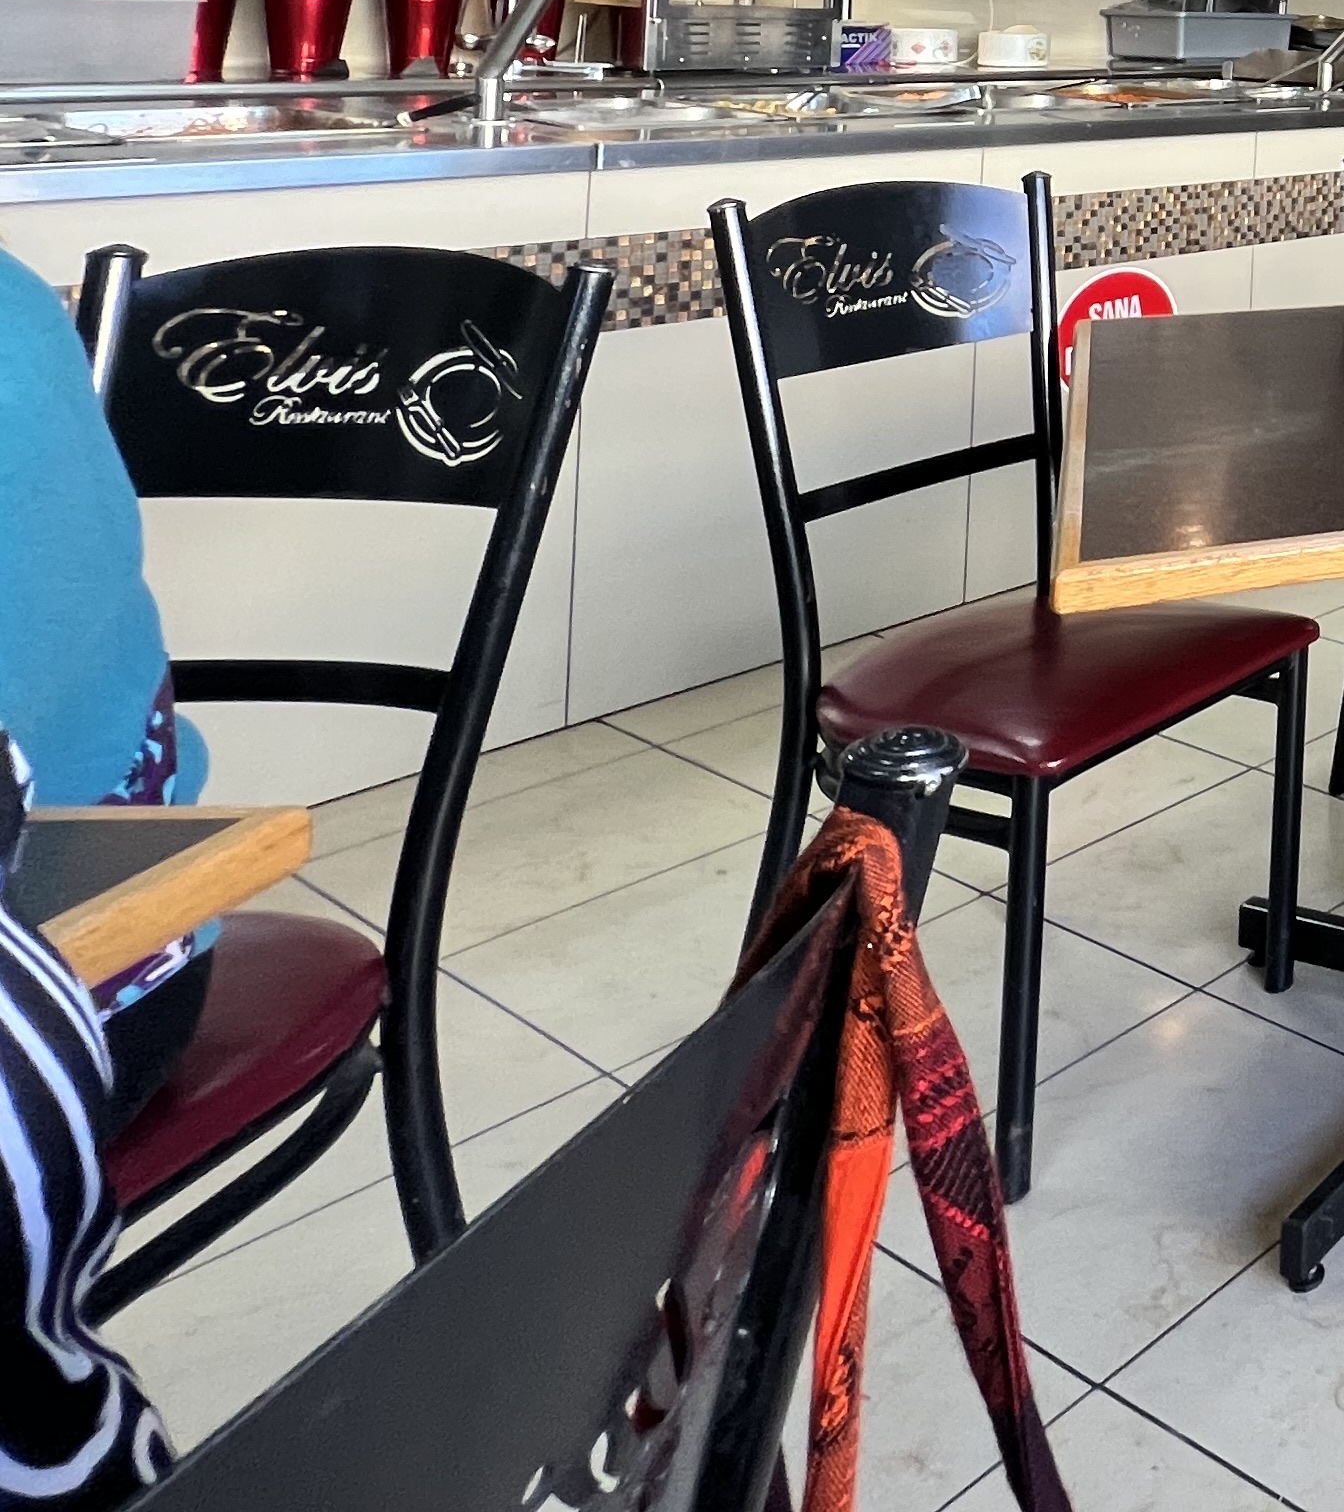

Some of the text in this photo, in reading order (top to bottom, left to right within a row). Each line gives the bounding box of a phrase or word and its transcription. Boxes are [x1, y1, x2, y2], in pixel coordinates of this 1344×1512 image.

[766, 233, 894, 305] Elvis
[1088, 294, 1143, 320] SANA
[152, 307, 389, 404] Elvis
[248, 394, 392, 426] Restaurant
